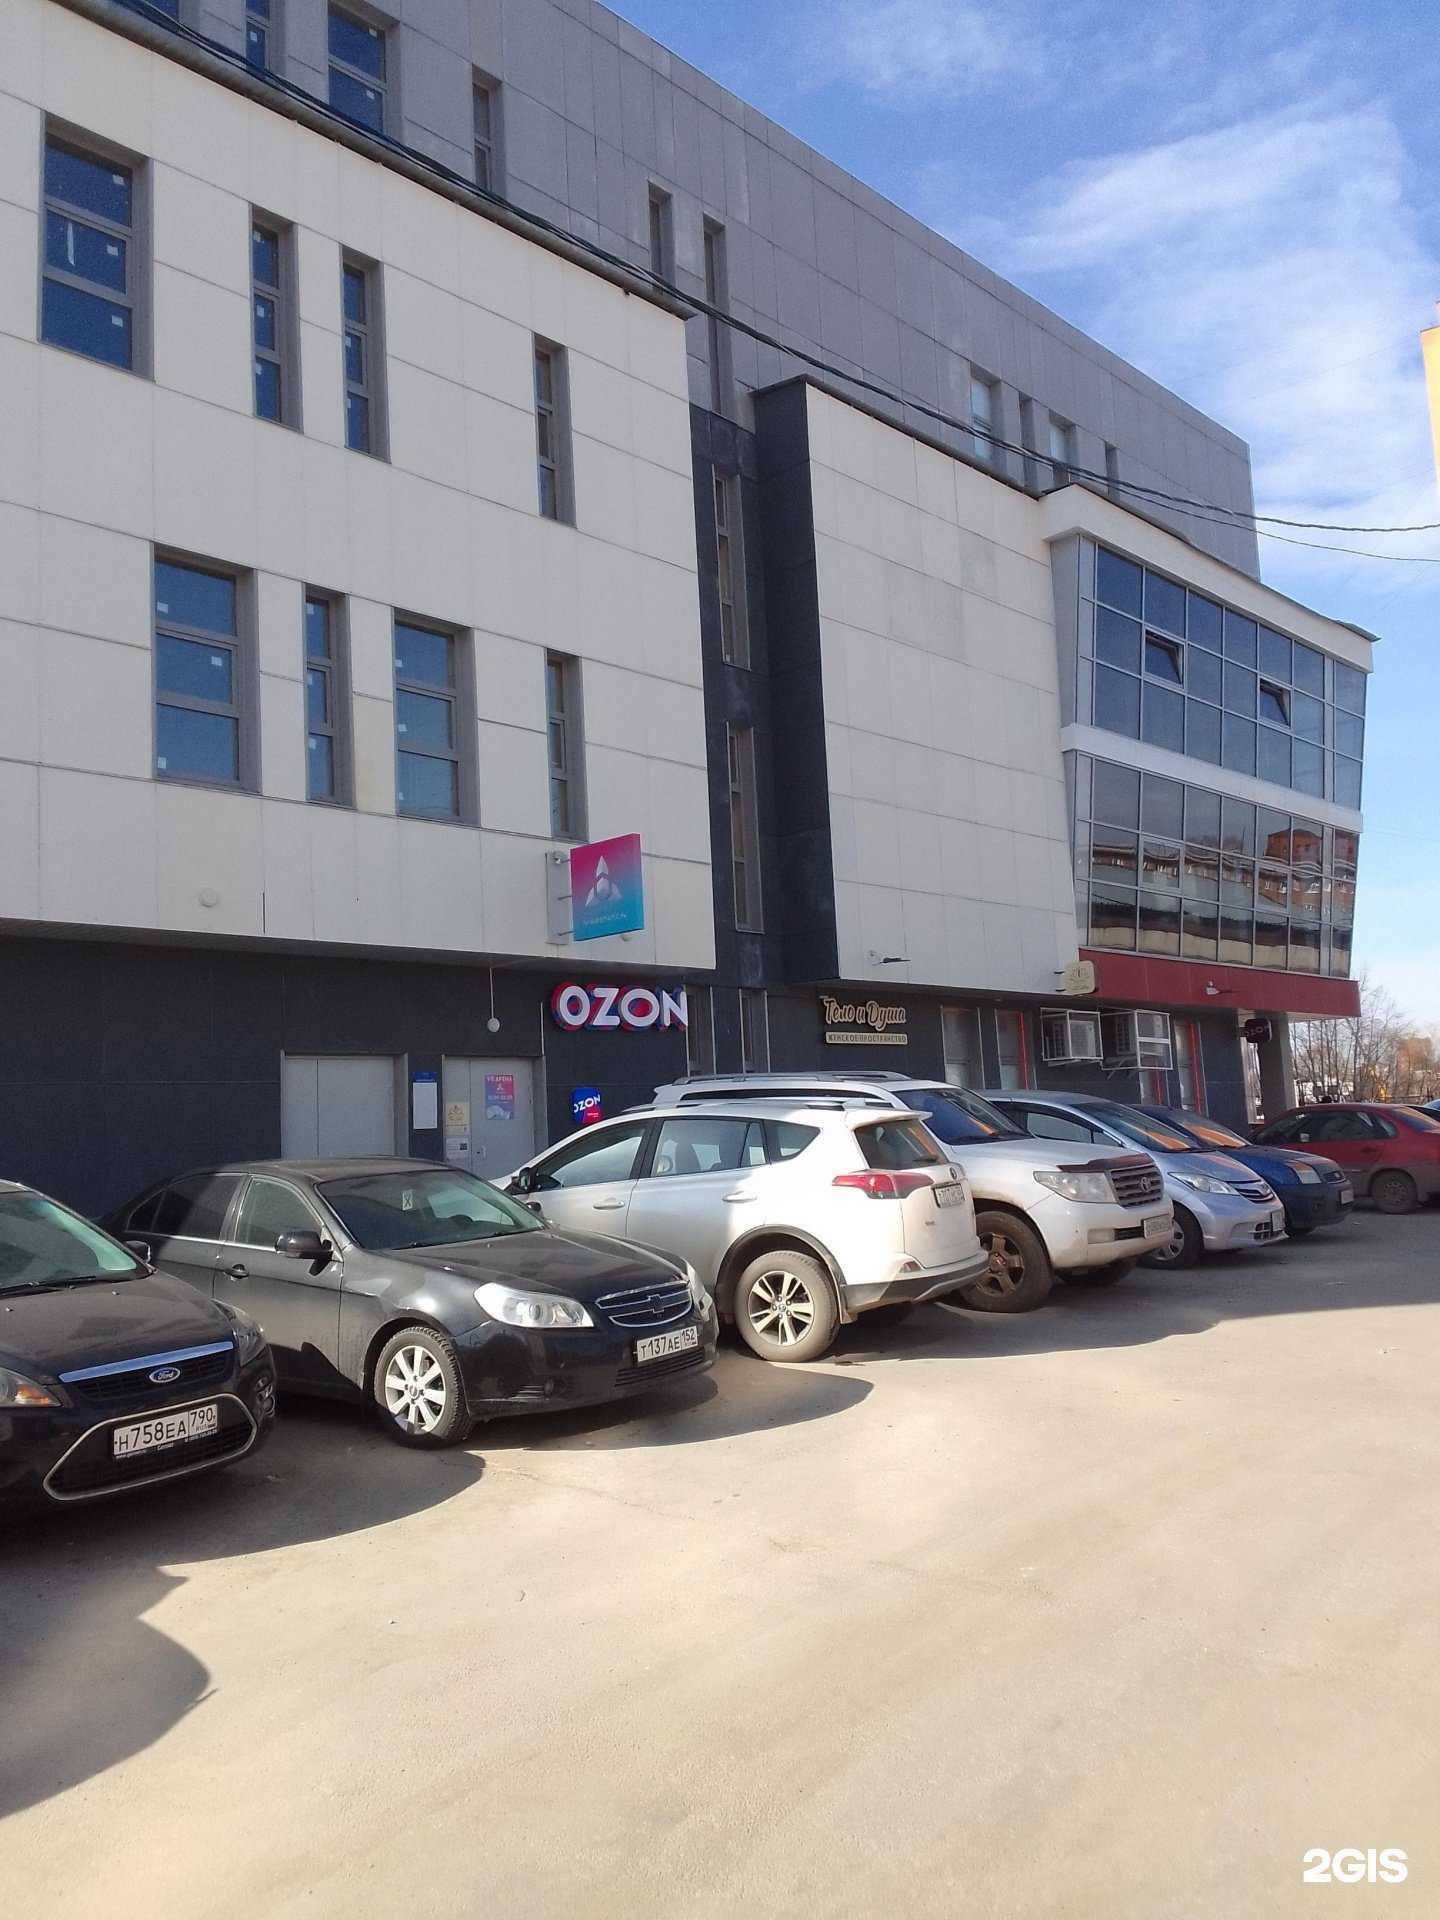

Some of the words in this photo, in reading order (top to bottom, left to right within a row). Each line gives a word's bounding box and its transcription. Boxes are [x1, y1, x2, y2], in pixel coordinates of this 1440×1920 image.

[556, 984, 689, 1028] OZON
[824, 998, 855, 1024] Тело
[856, 1006, 866, 1024] и
[865, 1000, 906, 1031] Душа
[681, 1328, 695, 1343] 152
[190, 1407, 214, 1427] 790
